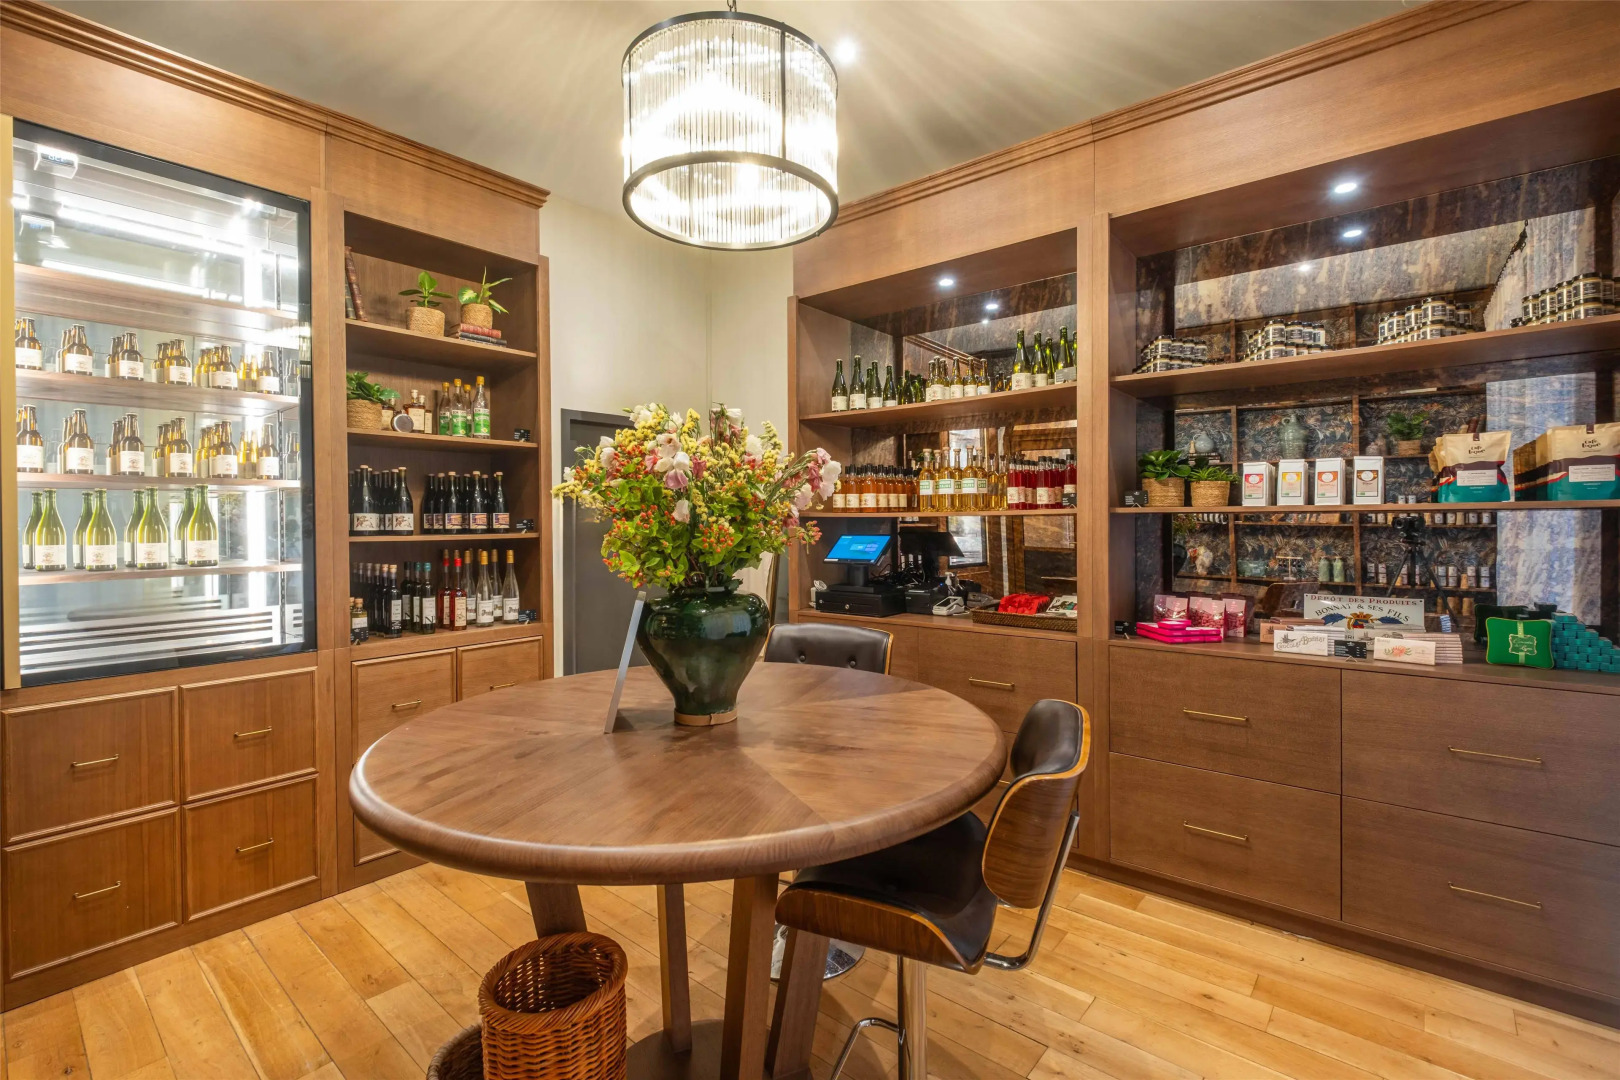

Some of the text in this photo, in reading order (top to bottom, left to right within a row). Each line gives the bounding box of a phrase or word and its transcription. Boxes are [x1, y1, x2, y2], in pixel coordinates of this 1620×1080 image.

[1369, 598, 1417, 606] PRODUITS
[1315, 603, 1352, 616] BONNAT
[1368, 604, 1384, 612] SES
[1387, 608, 1409, 622] FILS
